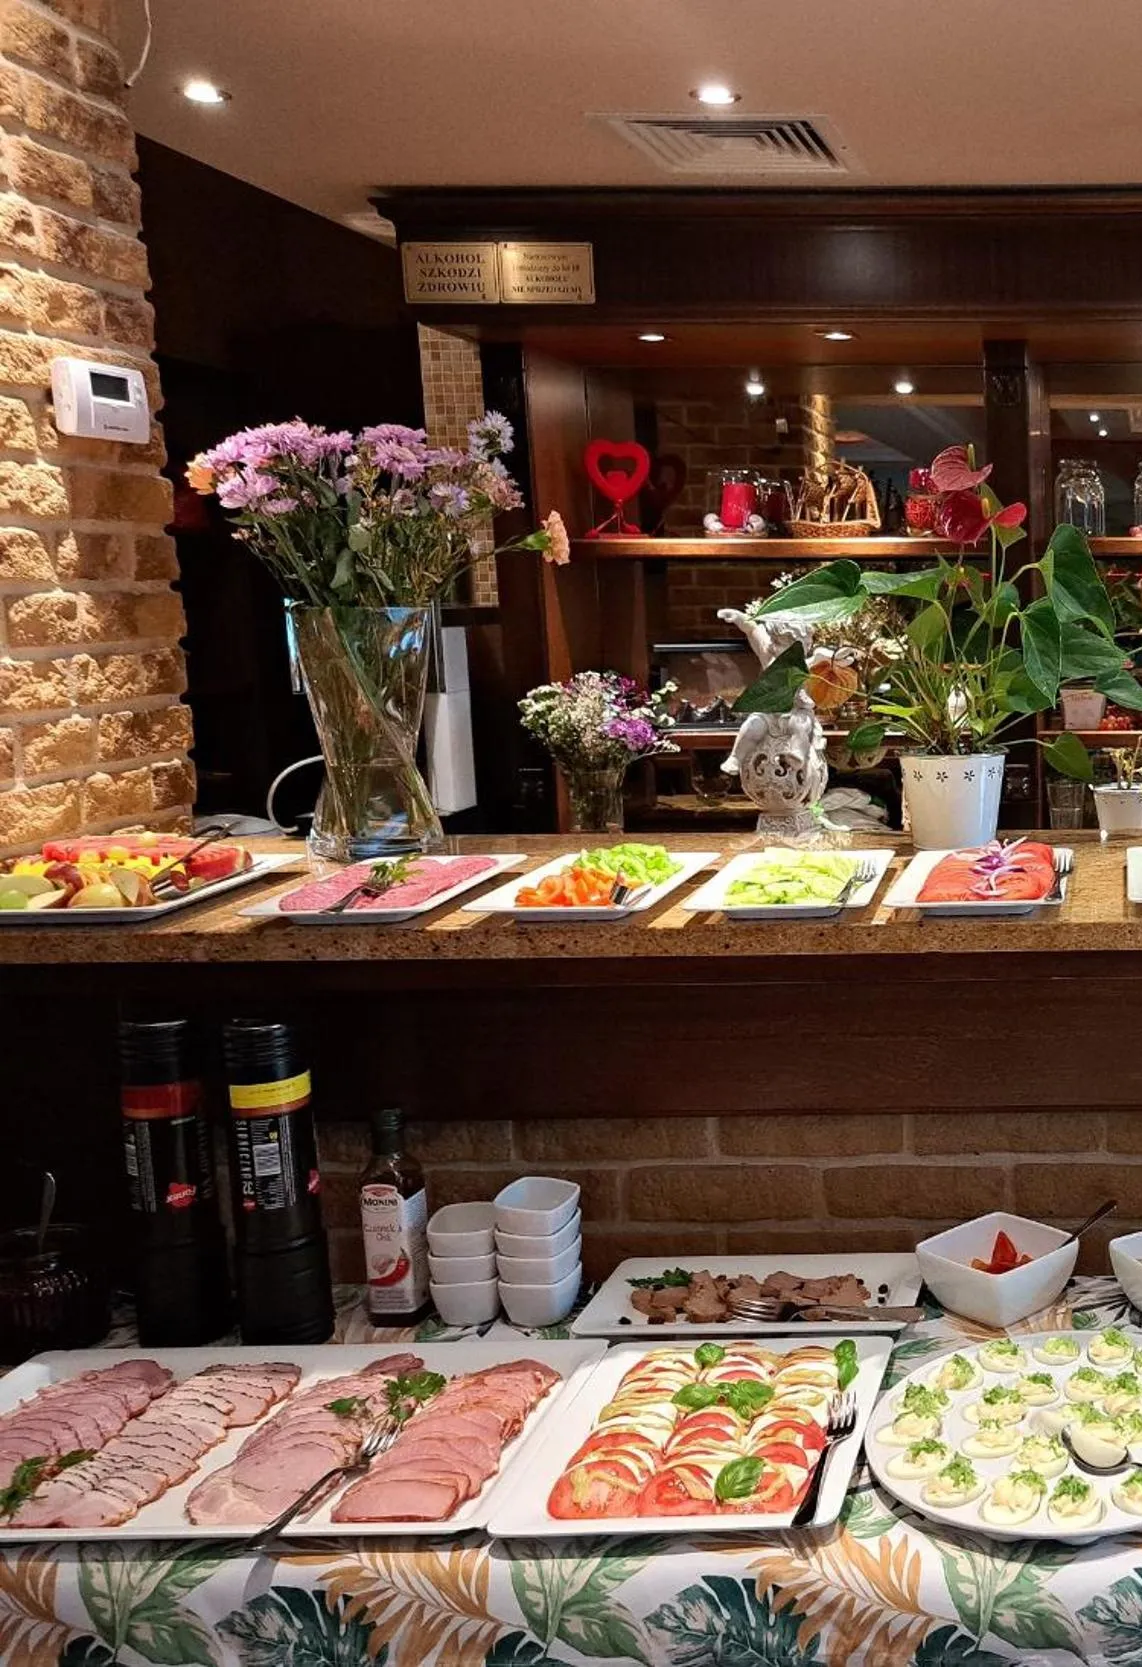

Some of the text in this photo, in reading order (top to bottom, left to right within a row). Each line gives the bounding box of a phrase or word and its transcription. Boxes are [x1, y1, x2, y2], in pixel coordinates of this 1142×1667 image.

[415, 252, 484, 264] ALKOHOL
[418, 267, 481, 278] SZKODZI
[416, 281, 484, 292] ZDROWIU
